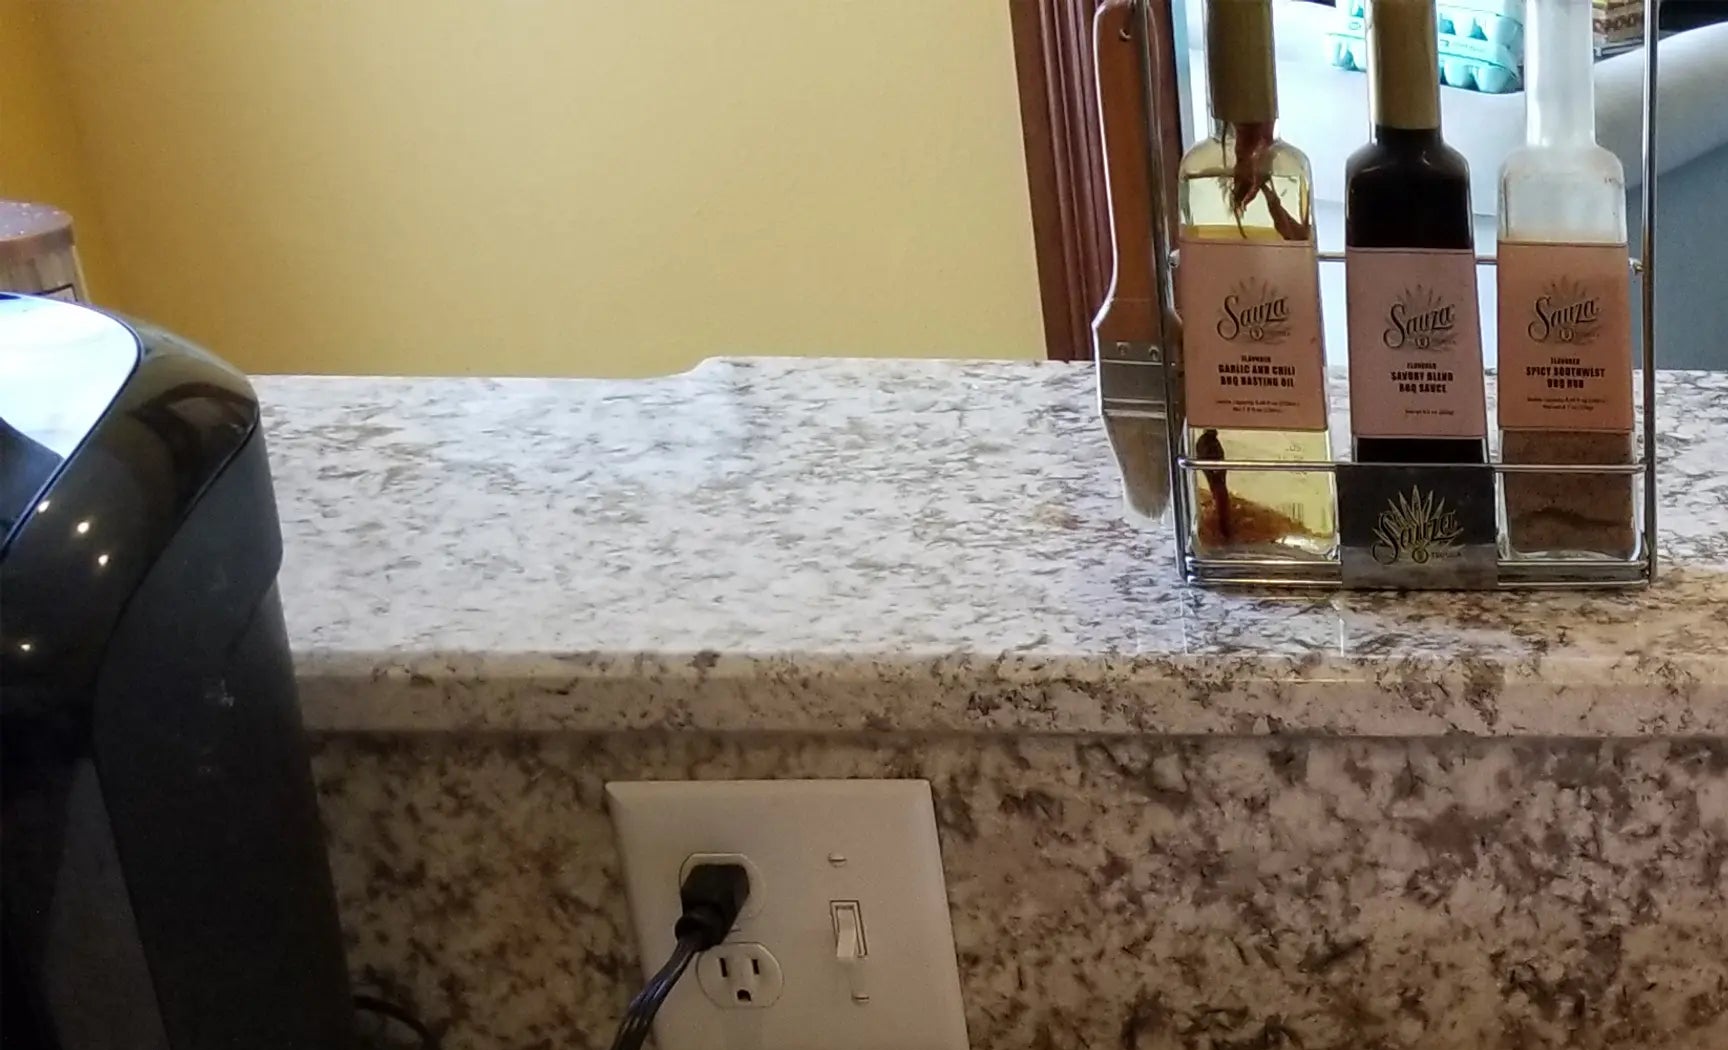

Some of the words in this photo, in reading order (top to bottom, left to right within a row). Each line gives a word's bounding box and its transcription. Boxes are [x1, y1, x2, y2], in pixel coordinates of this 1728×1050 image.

[1217, 295, 1290, 341] Sauza
[1528, 296, 1600, 342] Sauza
[1383, 303, 1455, 349] Sauza
[1218, 364, 1250, 374] GARLIC
[1252, 365, 1270, 374] AND
[1272, 366, 1295, 376] CHILI
[1526, 366, 1551, 377] SPICY
[1553, 367, 1605, 378] SOUTHWEST
[1220, 376, 1238, 386] BBQ
[1240, 376, 1279, 387] BASTING
[1281, 378, 1294, 387] OIL
[1391, 371, 1424, 381] SAVORY
[1427, 372, 1454, 382] BLEND
[1399, 384, 1417, 394] BBQ
[1419, 384, 1447, 393] SAUCE
[1371, 510, 1458, 565] Sauza
